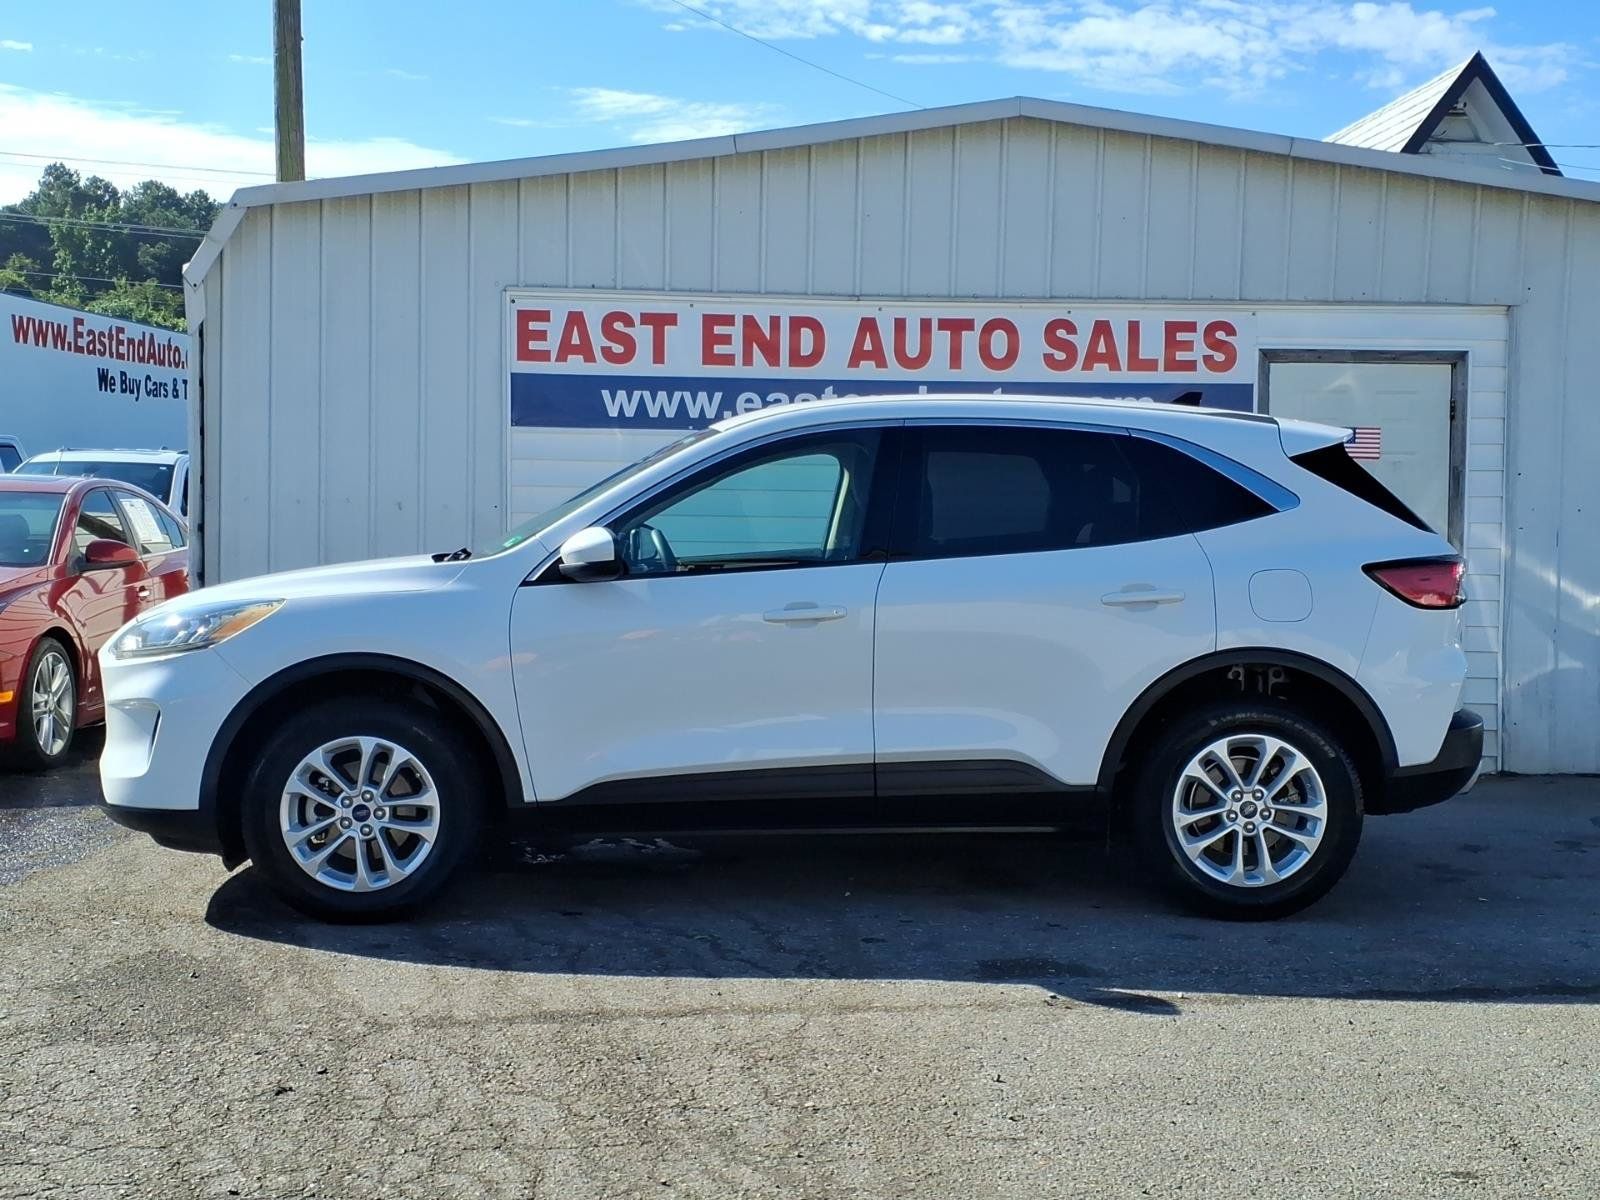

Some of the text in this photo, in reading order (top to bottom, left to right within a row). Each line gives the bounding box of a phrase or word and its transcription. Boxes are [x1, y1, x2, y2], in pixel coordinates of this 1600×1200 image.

[11, 314, 189, 370] www.EastEndAuto.
[515, 308, 1239, 374] EAST END AUTO SALES
[97, 367, 116, 394] We
[119, 371, 142, 402] Buy
[144, 374, 169, 399] Cars
[171, 377, 180, 400] &
